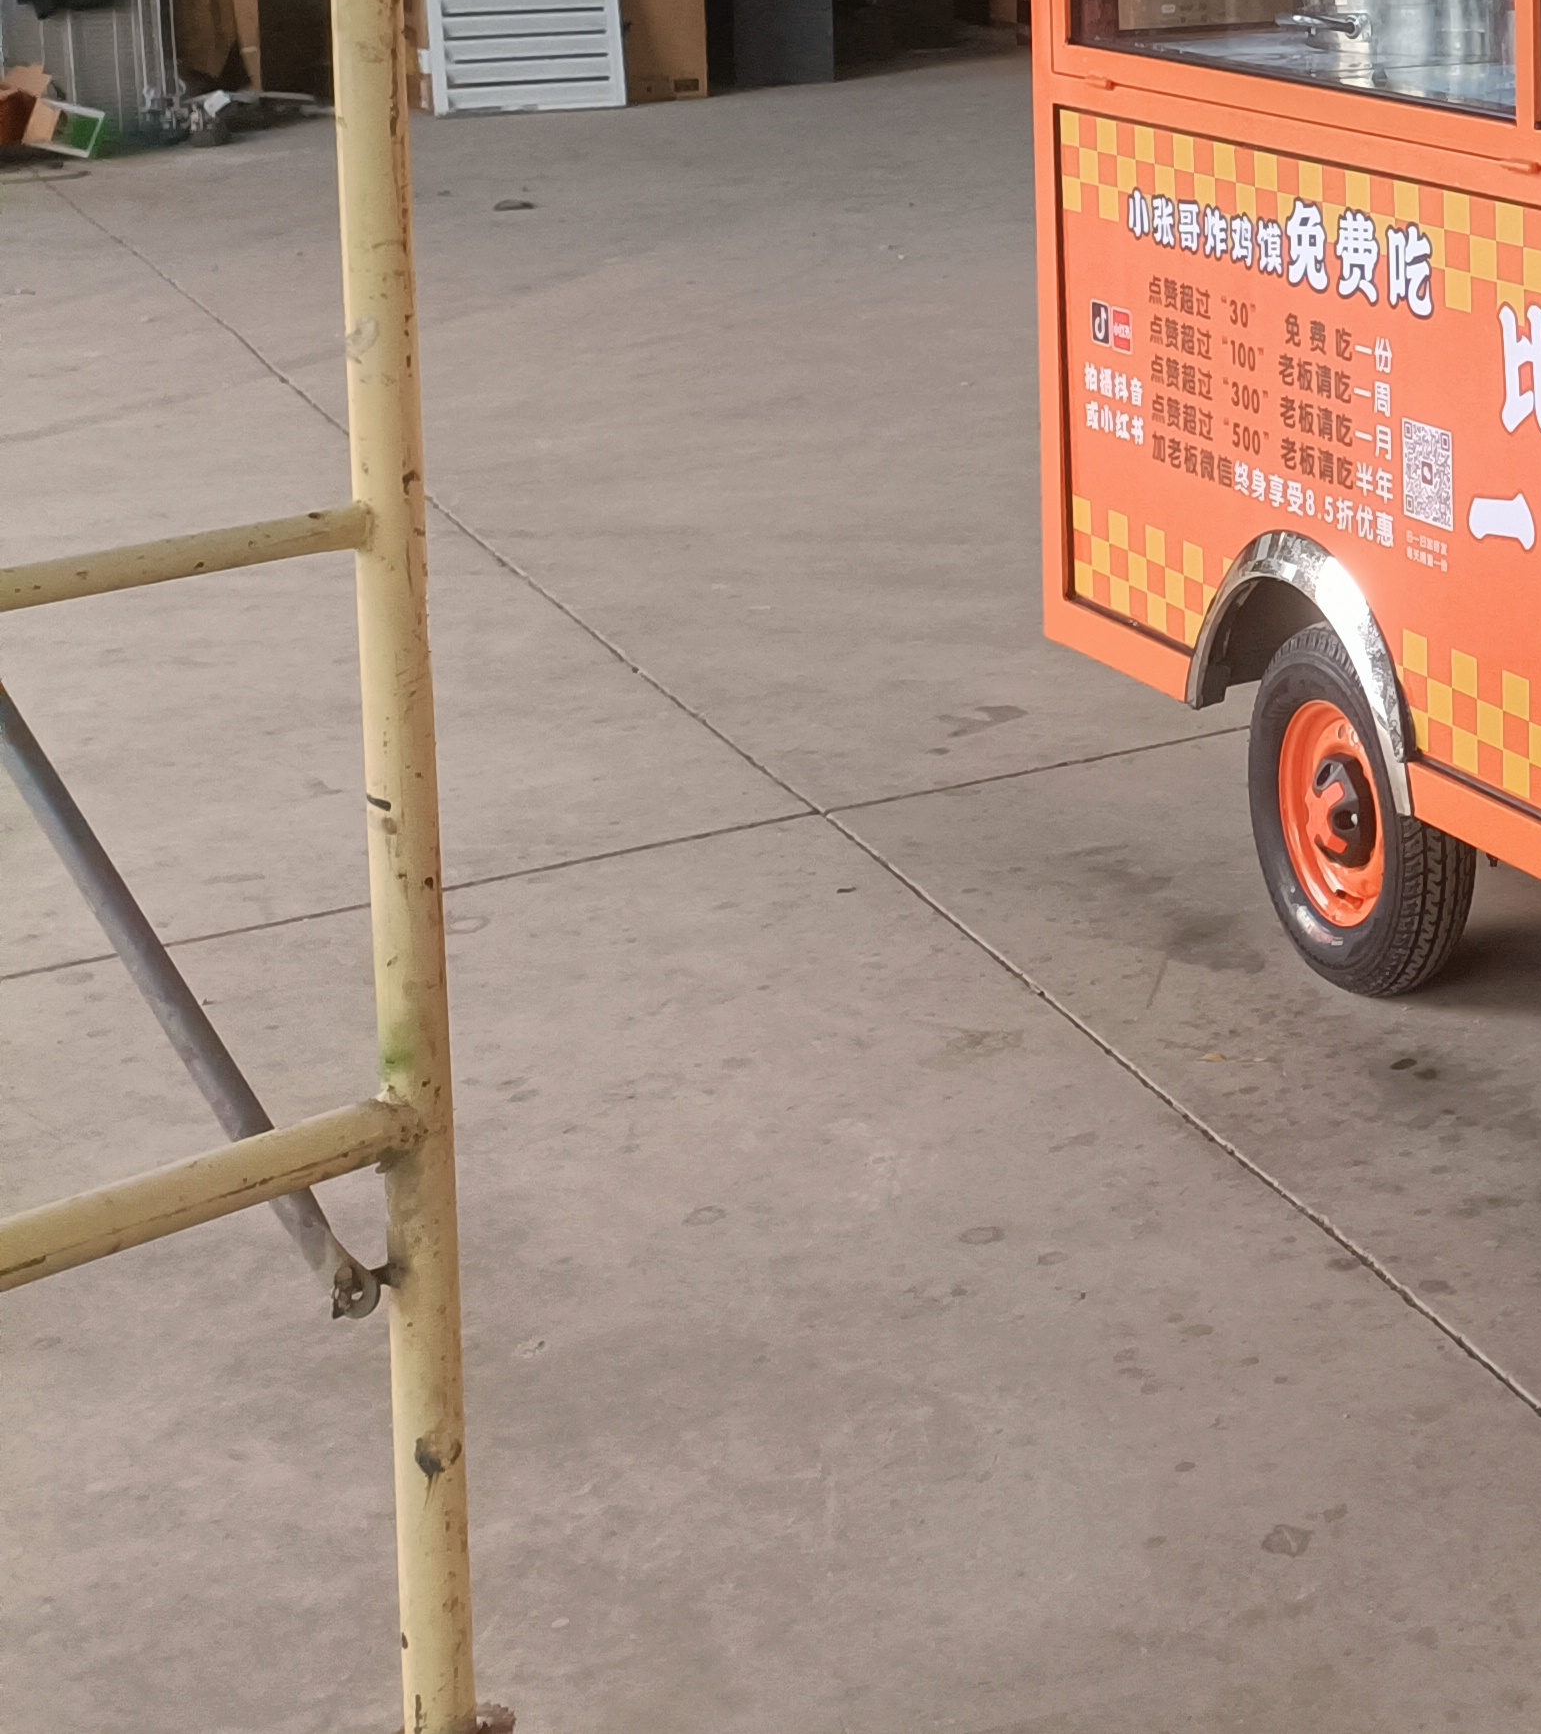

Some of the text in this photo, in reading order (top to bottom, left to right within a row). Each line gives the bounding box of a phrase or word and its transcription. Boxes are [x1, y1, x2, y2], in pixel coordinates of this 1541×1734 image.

[1128, 191, 1432, 315] 小张哥炸鸡馍免费吃
[1149, 275, 1211, 320] 点赞超过
[1085, 362, 1143, 407] 拍摄抖音
[1150, 314, 1212, 360] 点赞超过
[1278, 354, 1391, 418] 老板请吃一周
[1151, 354, 1213, 401] 点赞超过
[1280, 396, 1392, 461] 老板请吃一月
[1086, 401, 1144, 445] 或小红书
[1152, 393, 1213, 441] 点赞超过
[1280, 437, 1394, 504] 老板请吃半年
